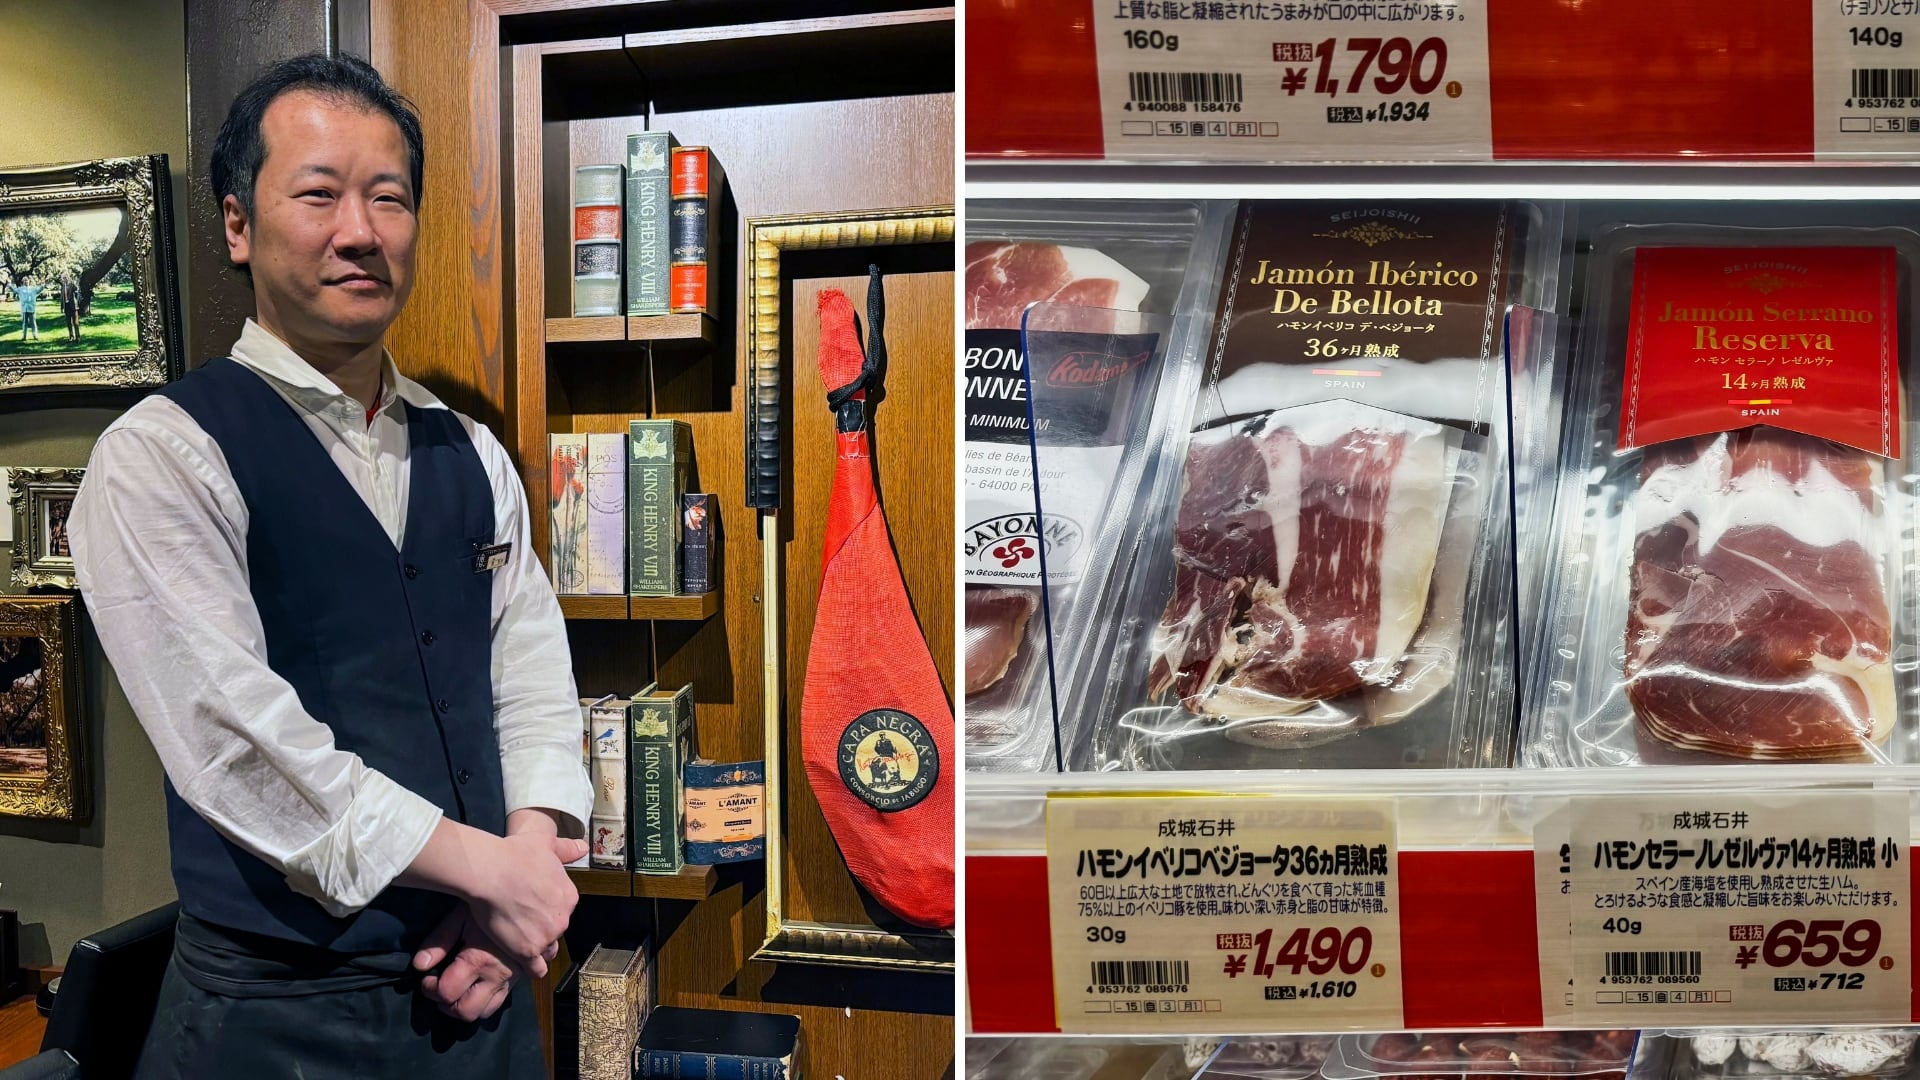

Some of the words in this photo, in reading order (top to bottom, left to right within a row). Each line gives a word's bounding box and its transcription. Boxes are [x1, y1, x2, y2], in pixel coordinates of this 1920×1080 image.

[1123, 30, 1179, 52] 160g
[1849, 27, 1903, 48] 140g
[1123, 102, 1132, 112] 4
[1138, 102, 1187, 112] 940088
[1194, 102, 1241, 112] 158476
[1844, 98, 1852, 108] 4
[1858, 98, 1905, 108] 953762
[1169, 123, 1184, 134] 15
[1887, 119, 1901, 130] 15
[642, 181, 656, 217] KING
[641, 219, 656, 268] HENRY
[641, 271, 656, 295] VIII
[1250, 260, 1355, 286] Jamón
[1366, 260, 1479, 287] Ibérico
[1271, 289, 1318, 315] De
[1327, 289, 1443, 316] Bellota
[1657, 300, 1754, 323] Jamón
[1762, 301, 1874, 324] Serrano
[1691, 325, 1835, 351] Reserva
[1323, 380, 1367, 390] SPAIN
[1741, 408, 1780, 417] SPAIN
[987, 450, 1001, 461] de
[1005, 465, 1020, 477] de
[643, 468, 658, 502] KING
[979, 479, 1018, 492] 64000
[643, 504, 658, 551] HENRY
[643, 554, 658, 577] VIII
[842, 723, 872, 763] CAPA
[876, 715, 931, 757] NEGRA
[644, 746, 660, 780] KING
[645, 783, 661, 835] HENRY
[718, 797, 758, 808] L'AMANT
[1158, 818, 1236, 838] 成城石井
[1673, 810, 1749, 830] 成城石井
[647, 838, 662, 855] VIII
[1881, 836, 1899, 868] 小
[1635, 875, 1860, 892] スペイン産海塩を使用し熟成させた生ハム。
[1086, 926, 1127, 944] 30g
[1602, 917, 1643, 936] 40g
[1600, 975, 1607, 985] 4
[1611, 975, 1653, 985] 953762
[1658, 975, 1700, 985] 089560
[1807, 973, 1866, 990] ¥712
[1086, 986, 1094, 995] 4
[1098, 985, 1140, 995] 953762
[1145, 985, 1188, 995] 089676
[1637, 992, 1649, 1002] 15
[1126, 1002, 1138, 1012] 15
